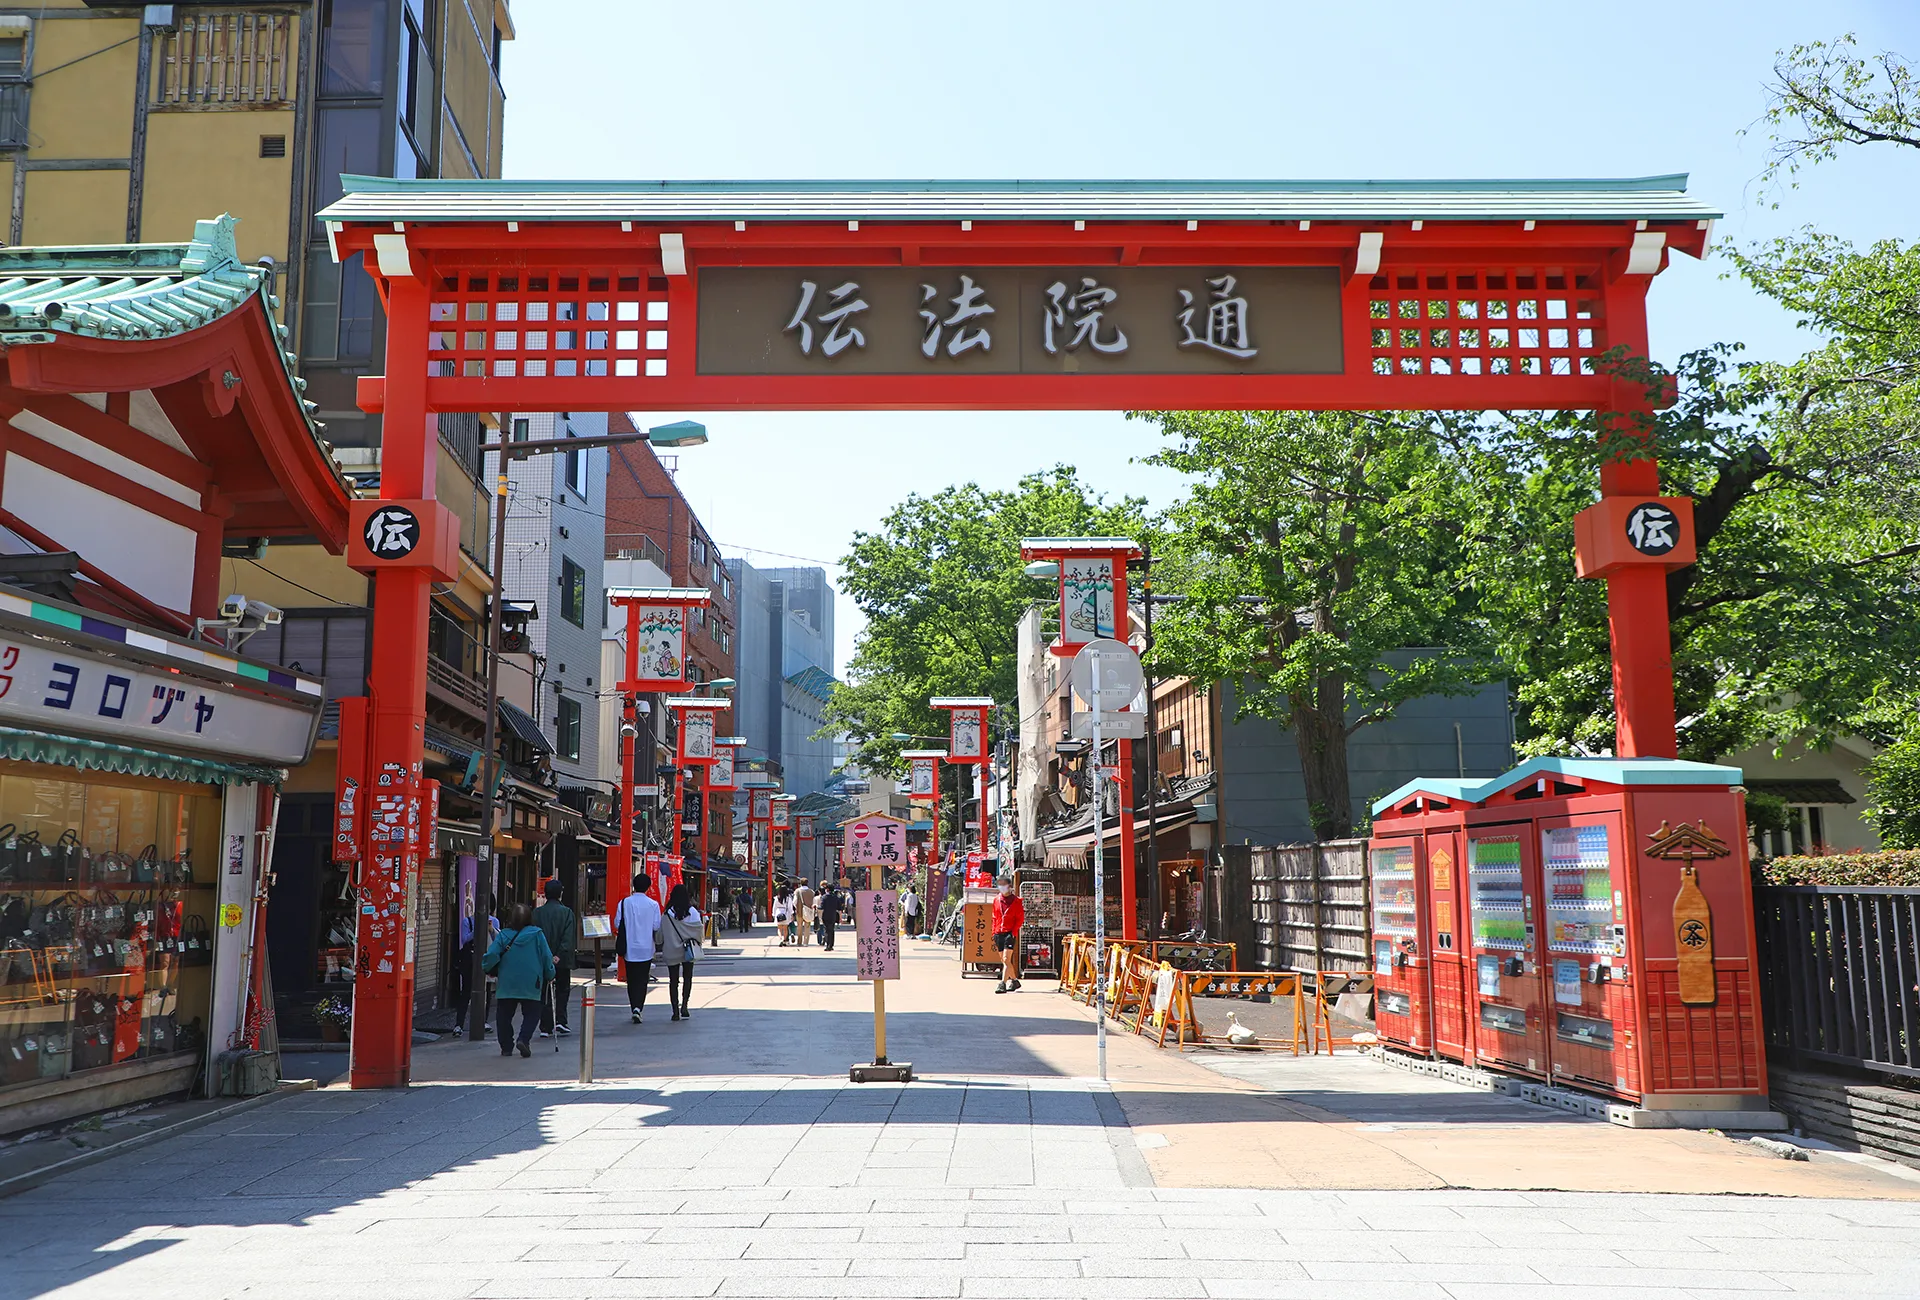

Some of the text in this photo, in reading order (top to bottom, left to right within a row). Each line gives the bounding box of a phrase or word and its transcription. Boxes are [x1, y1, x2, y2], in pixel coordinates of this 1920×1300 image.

[783, 274, 1258, 359] 伝法院通
[366, 511, 413, 552] 伝
[1627, 508, 1674, 549] 伝
[851, 840, 861, 864] 通行止
[877, 823, 899, 862] 下馬
[975, 918, 986, 957] おじま
[1683, 923, 1706, 946] 茶
[1208, 982, 1276, 992] 台東区土木部
